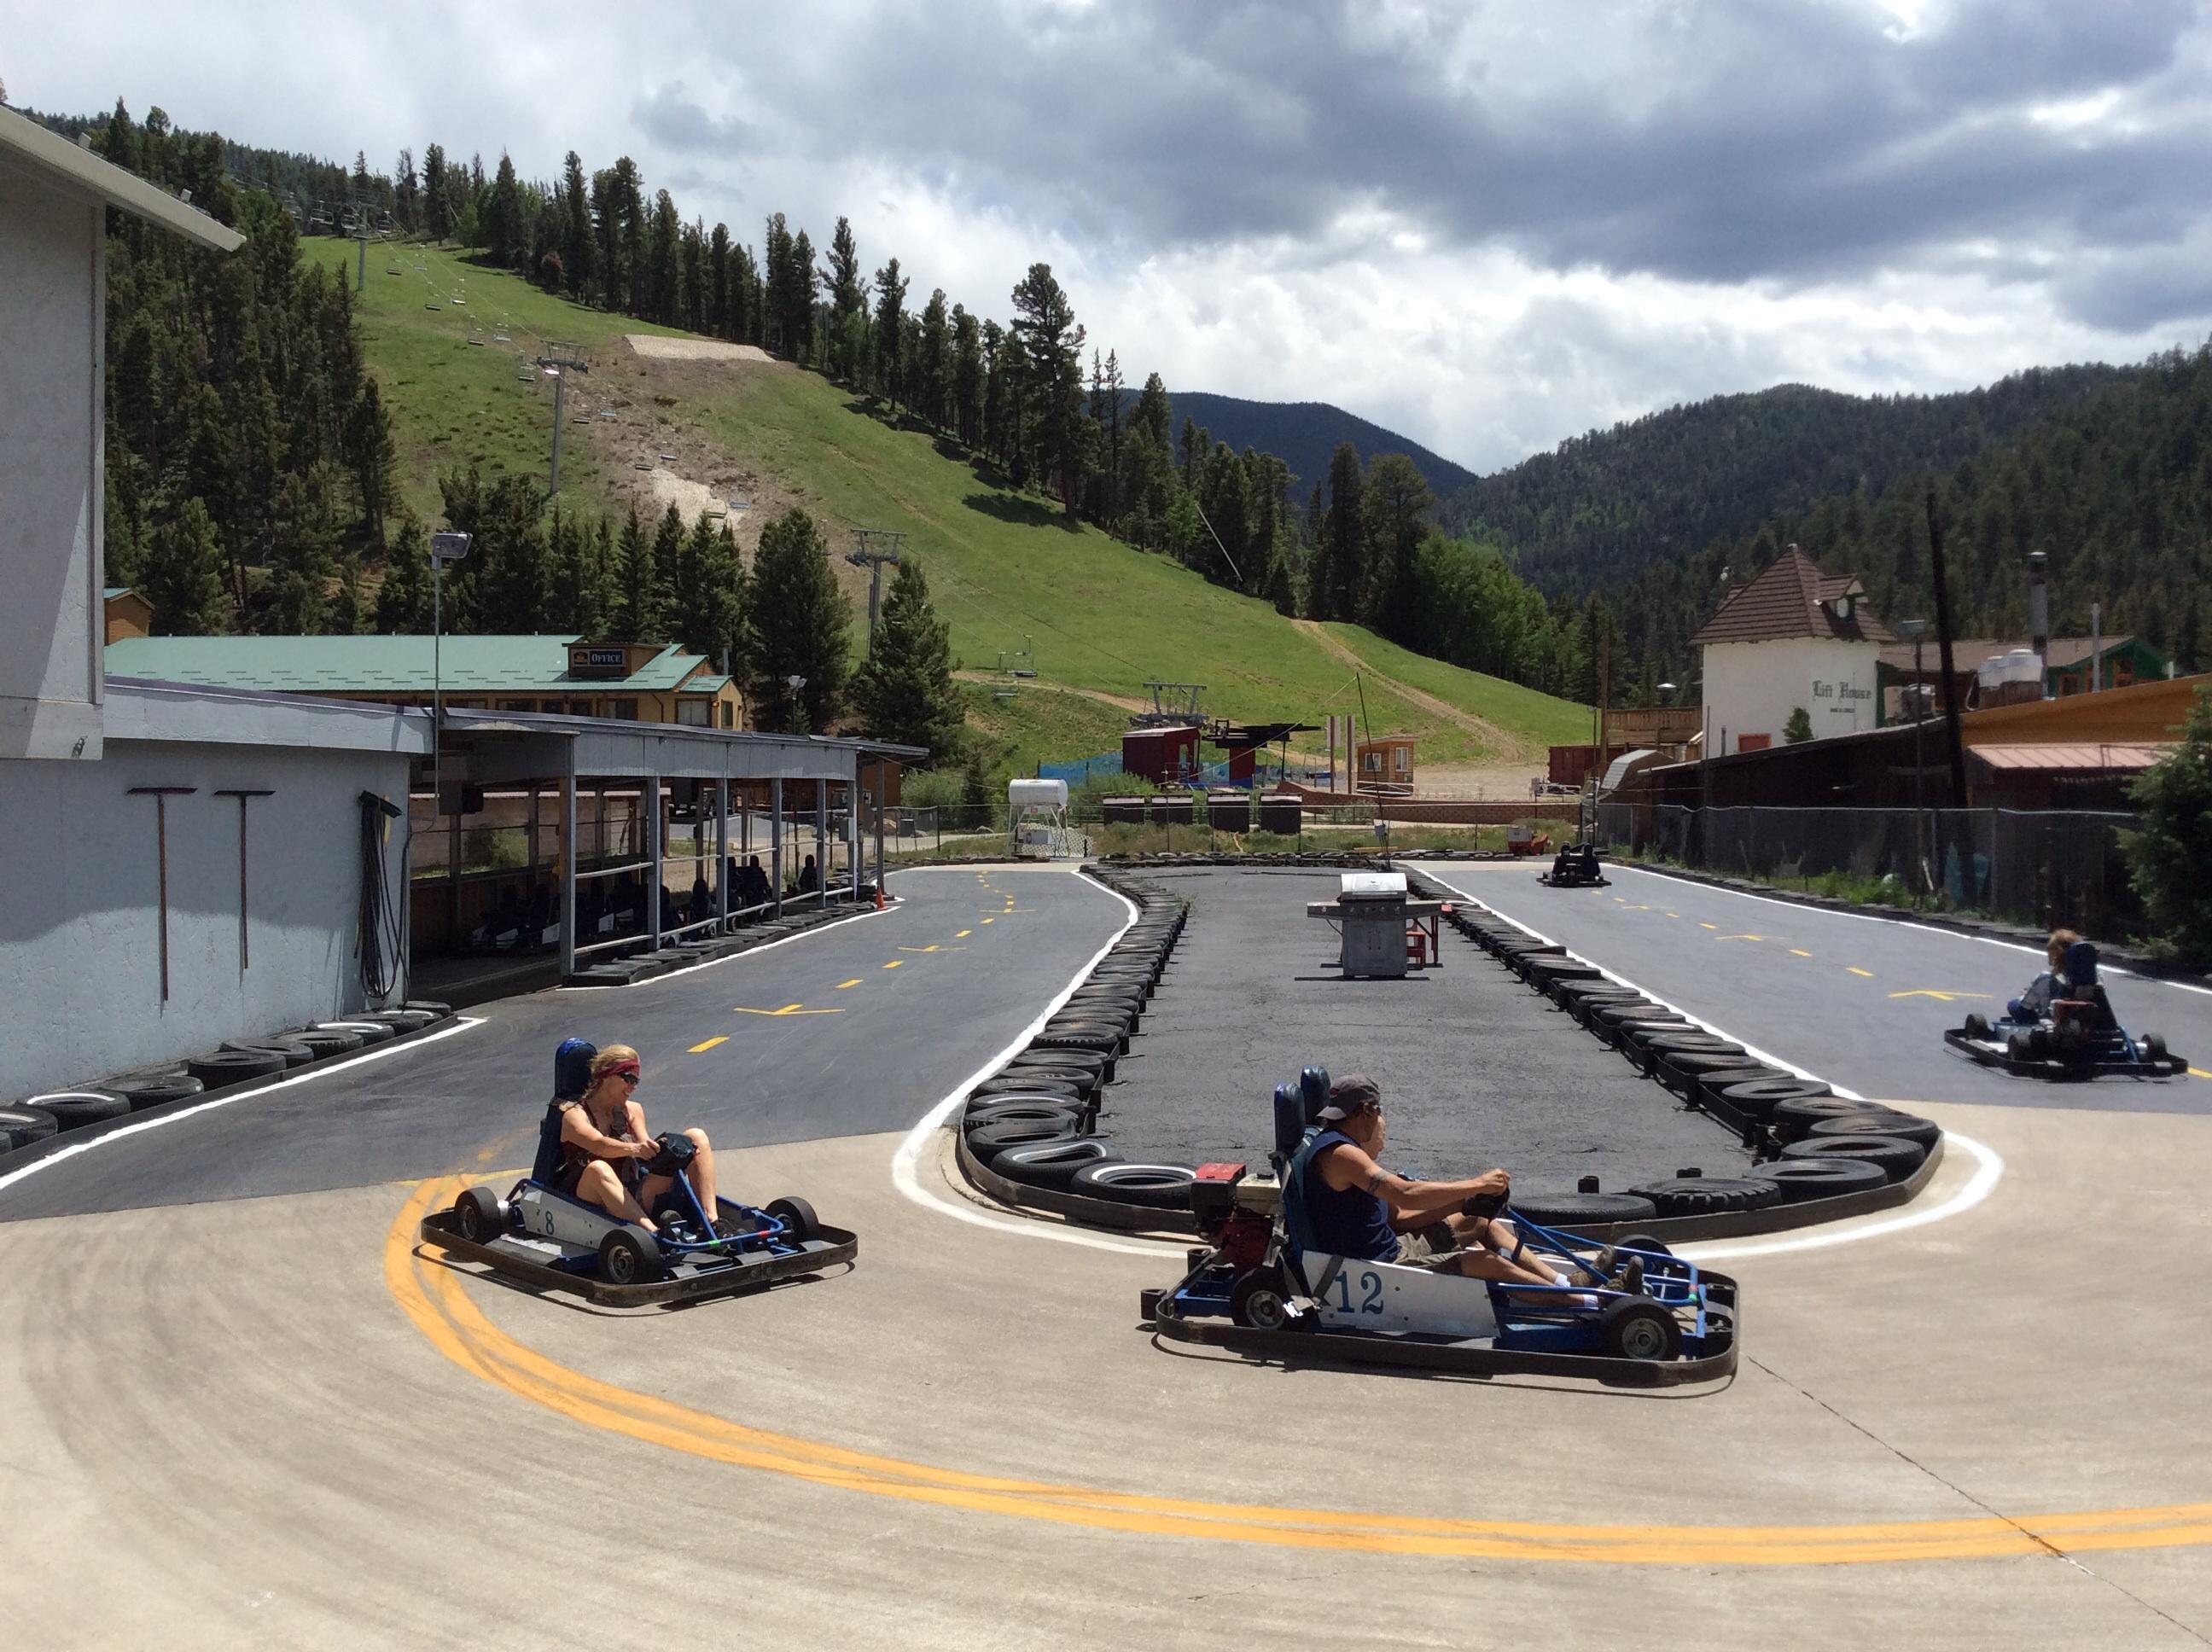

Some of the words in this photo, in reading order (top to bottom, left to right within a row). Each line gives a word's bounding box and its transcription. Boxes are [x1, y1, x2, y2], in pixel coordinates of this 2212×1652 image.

[1812, 680, 1833, 698] Lift
[1838, 682, 1871, 699] House
[545, 1211, 555, 1236] 8
[1335, 1271, 1384, 1314] 12
